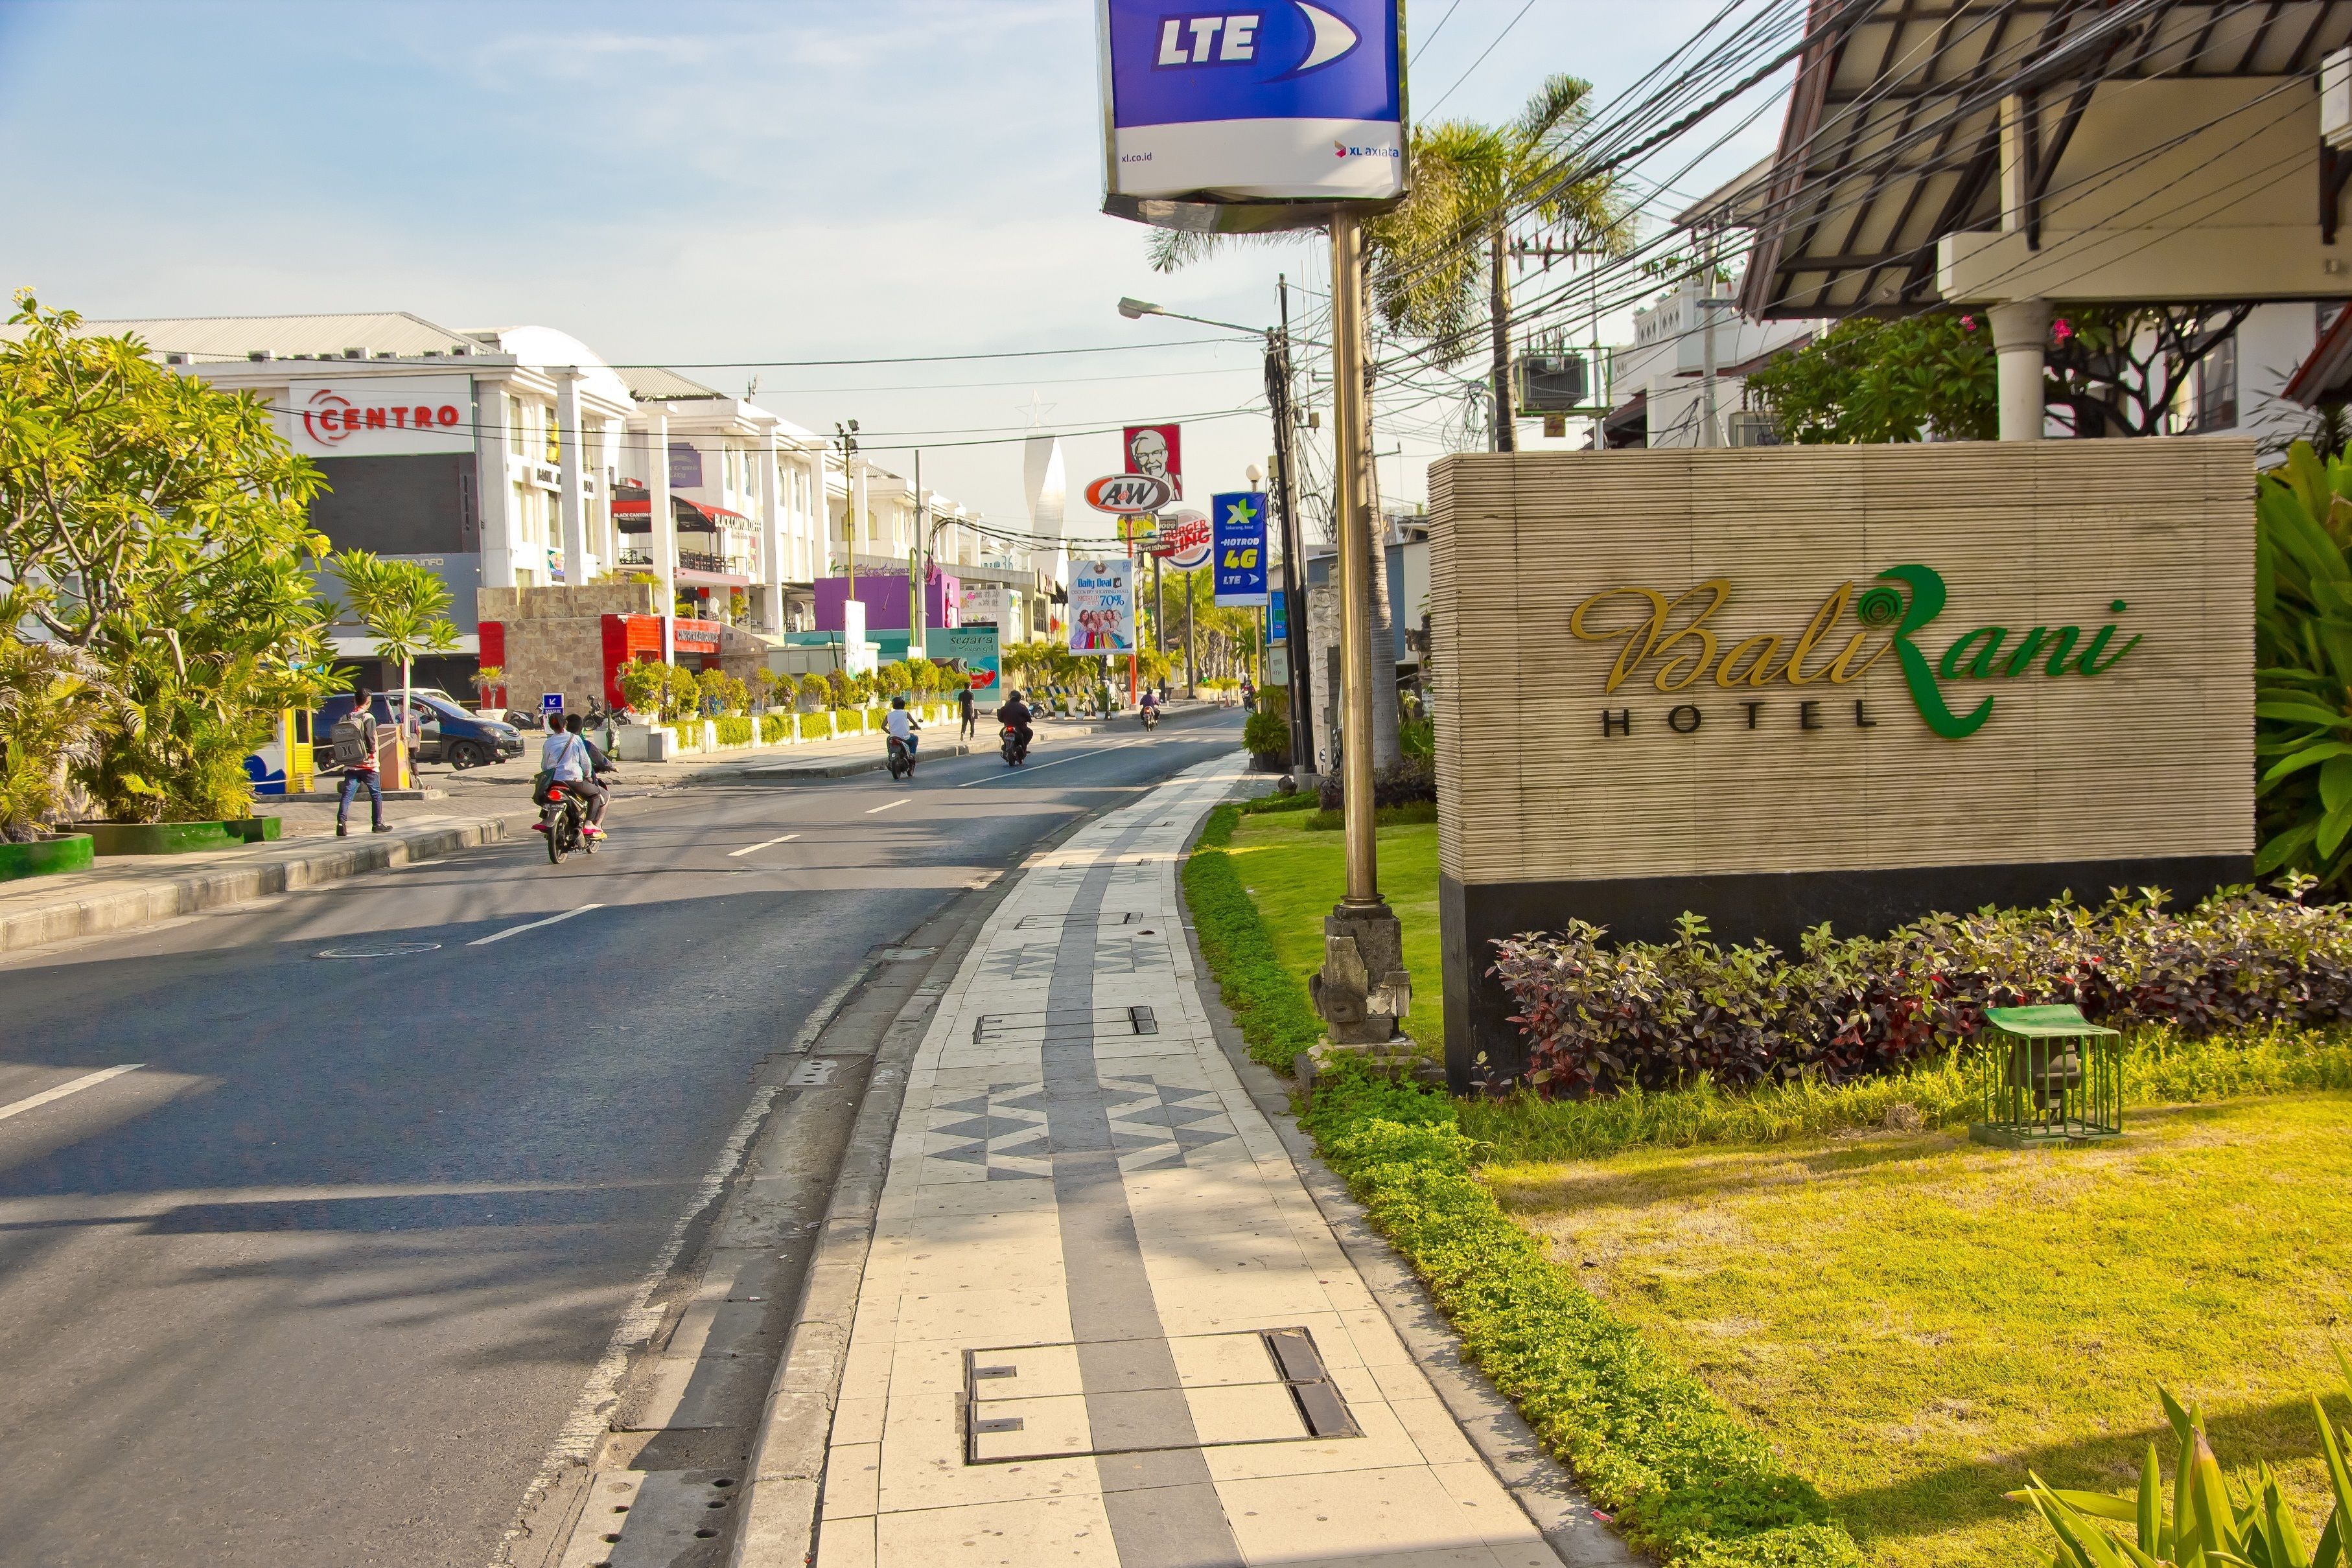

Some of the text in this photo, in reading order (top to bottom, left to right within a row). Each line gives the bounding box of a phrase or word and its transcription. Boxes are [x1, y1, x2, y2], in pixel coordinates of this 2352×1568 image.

[1158, 15, 1259, 65] LTE
[1121, 152, 1152, 163] xl.co.id
[1349, 146, 1399, 157] XL axiata
[320, 404, 460, 432] CENTRO
[1100, 482, 1157, 505] A&W
[1226, 498, 1257, 524] XL
[714, 513, 731, 528] BLACK
[731, 515, 749, 531] CANYON
[1163, 519, 1207, 541] BURGER
[1223, 537, 1260, 546] HOTROD
[1224, 548, 1258, 569] 4G
[1078, 577, 1095, 589] Daily
[1097, 577, 1112, 587] Deal
[1223, 575, 1242, 584] LTE
[1099, 595, 1124, 606] 70%
[1569, 564, 2143, 739] Bali Rani
[1603, 698, 1877, 738] HOTEL
